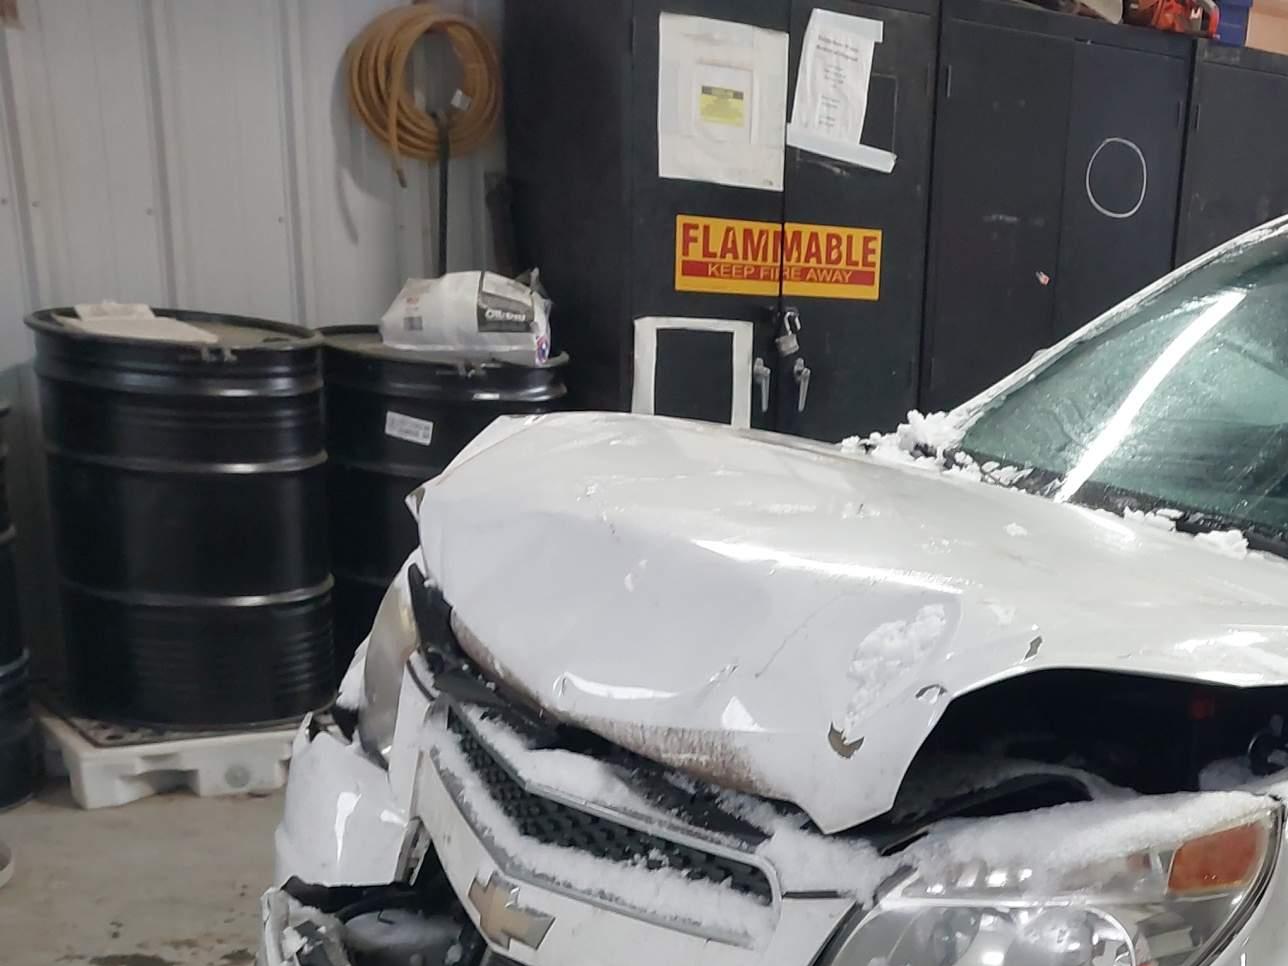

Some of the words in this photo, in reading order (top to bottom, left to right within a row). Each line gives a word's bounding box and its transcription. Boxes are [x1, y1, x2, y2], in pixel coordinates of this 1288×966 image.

[682, 222, 878, 267] FLAMMABLE
[707, 263, 754, 278] KEEP
[760, 266, 801, 281] FIRE
[806, 268, 853, 283] AWAY
